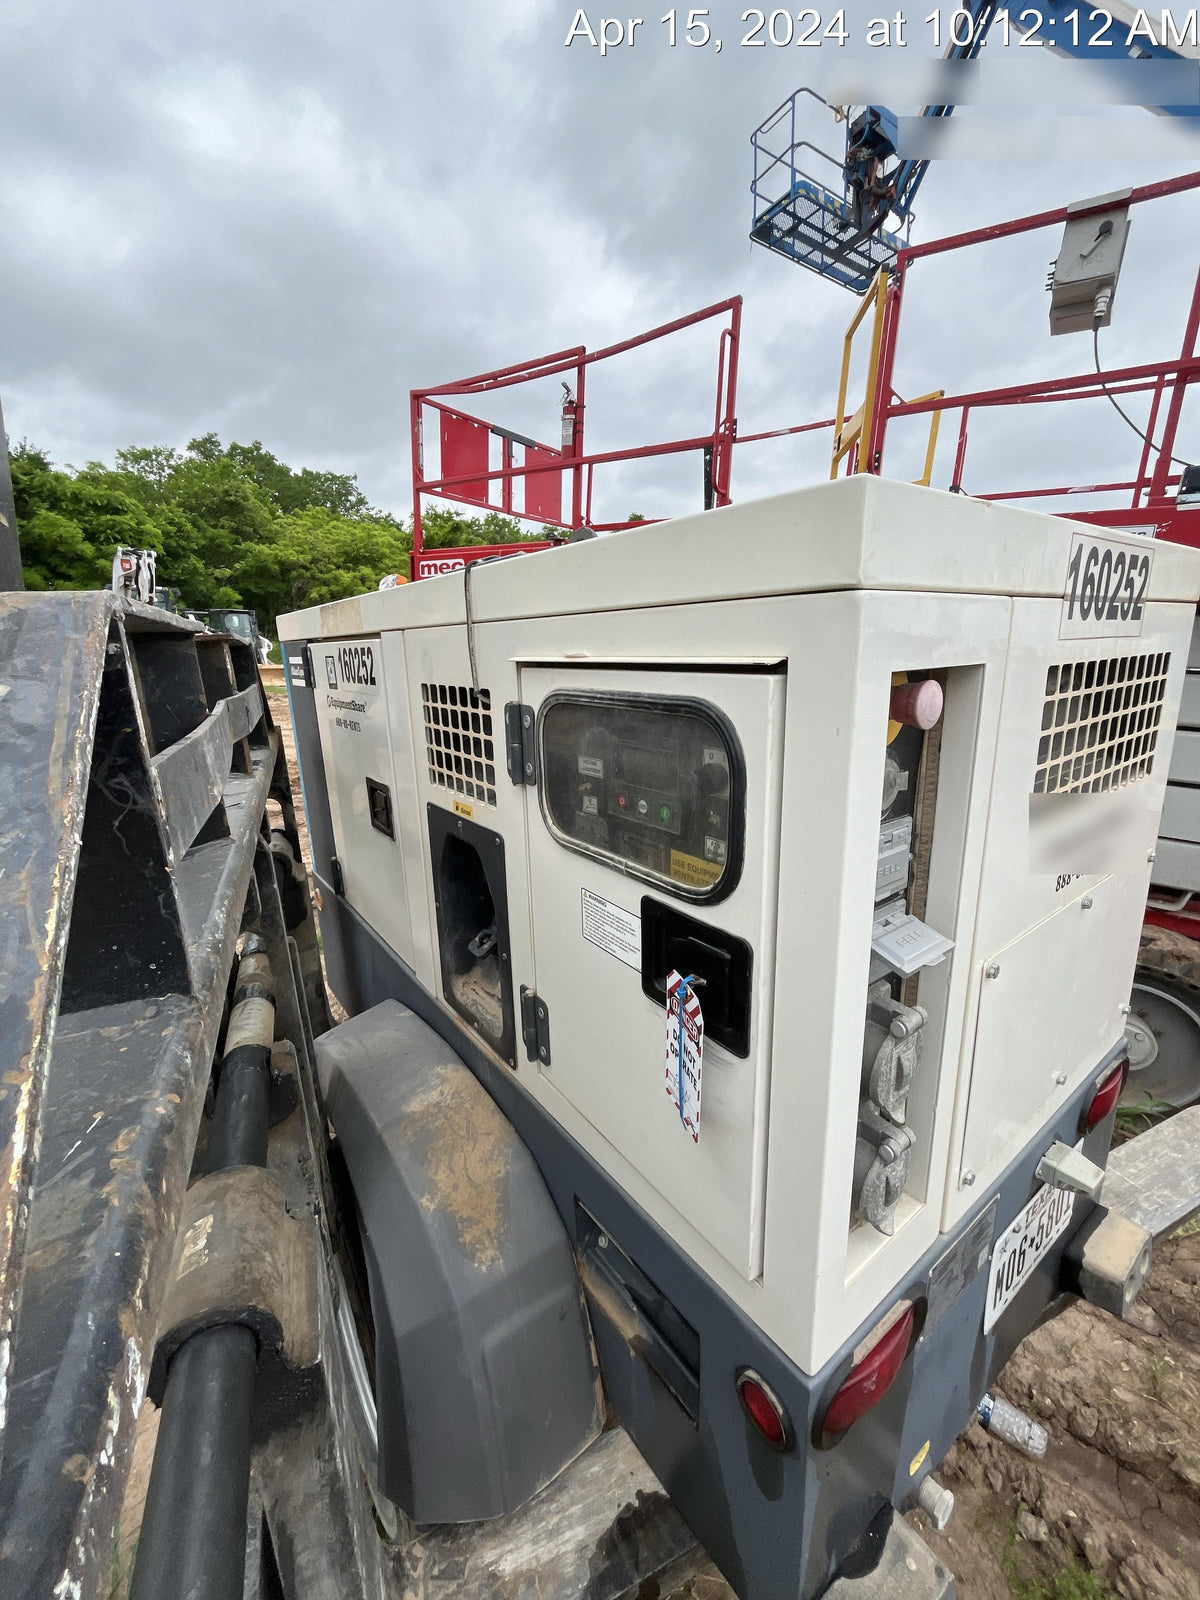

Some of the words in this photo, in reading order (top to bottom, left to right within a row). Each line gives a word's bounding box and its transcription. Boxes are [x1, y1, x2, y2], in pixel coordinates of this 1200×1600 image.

[1067, 542, 1150, 622] 160252
[338, 646, 377, 686] 160252
[670, 1042, 698, 1092] OPRATE
[683, 1043, 696, 1069] NOT
